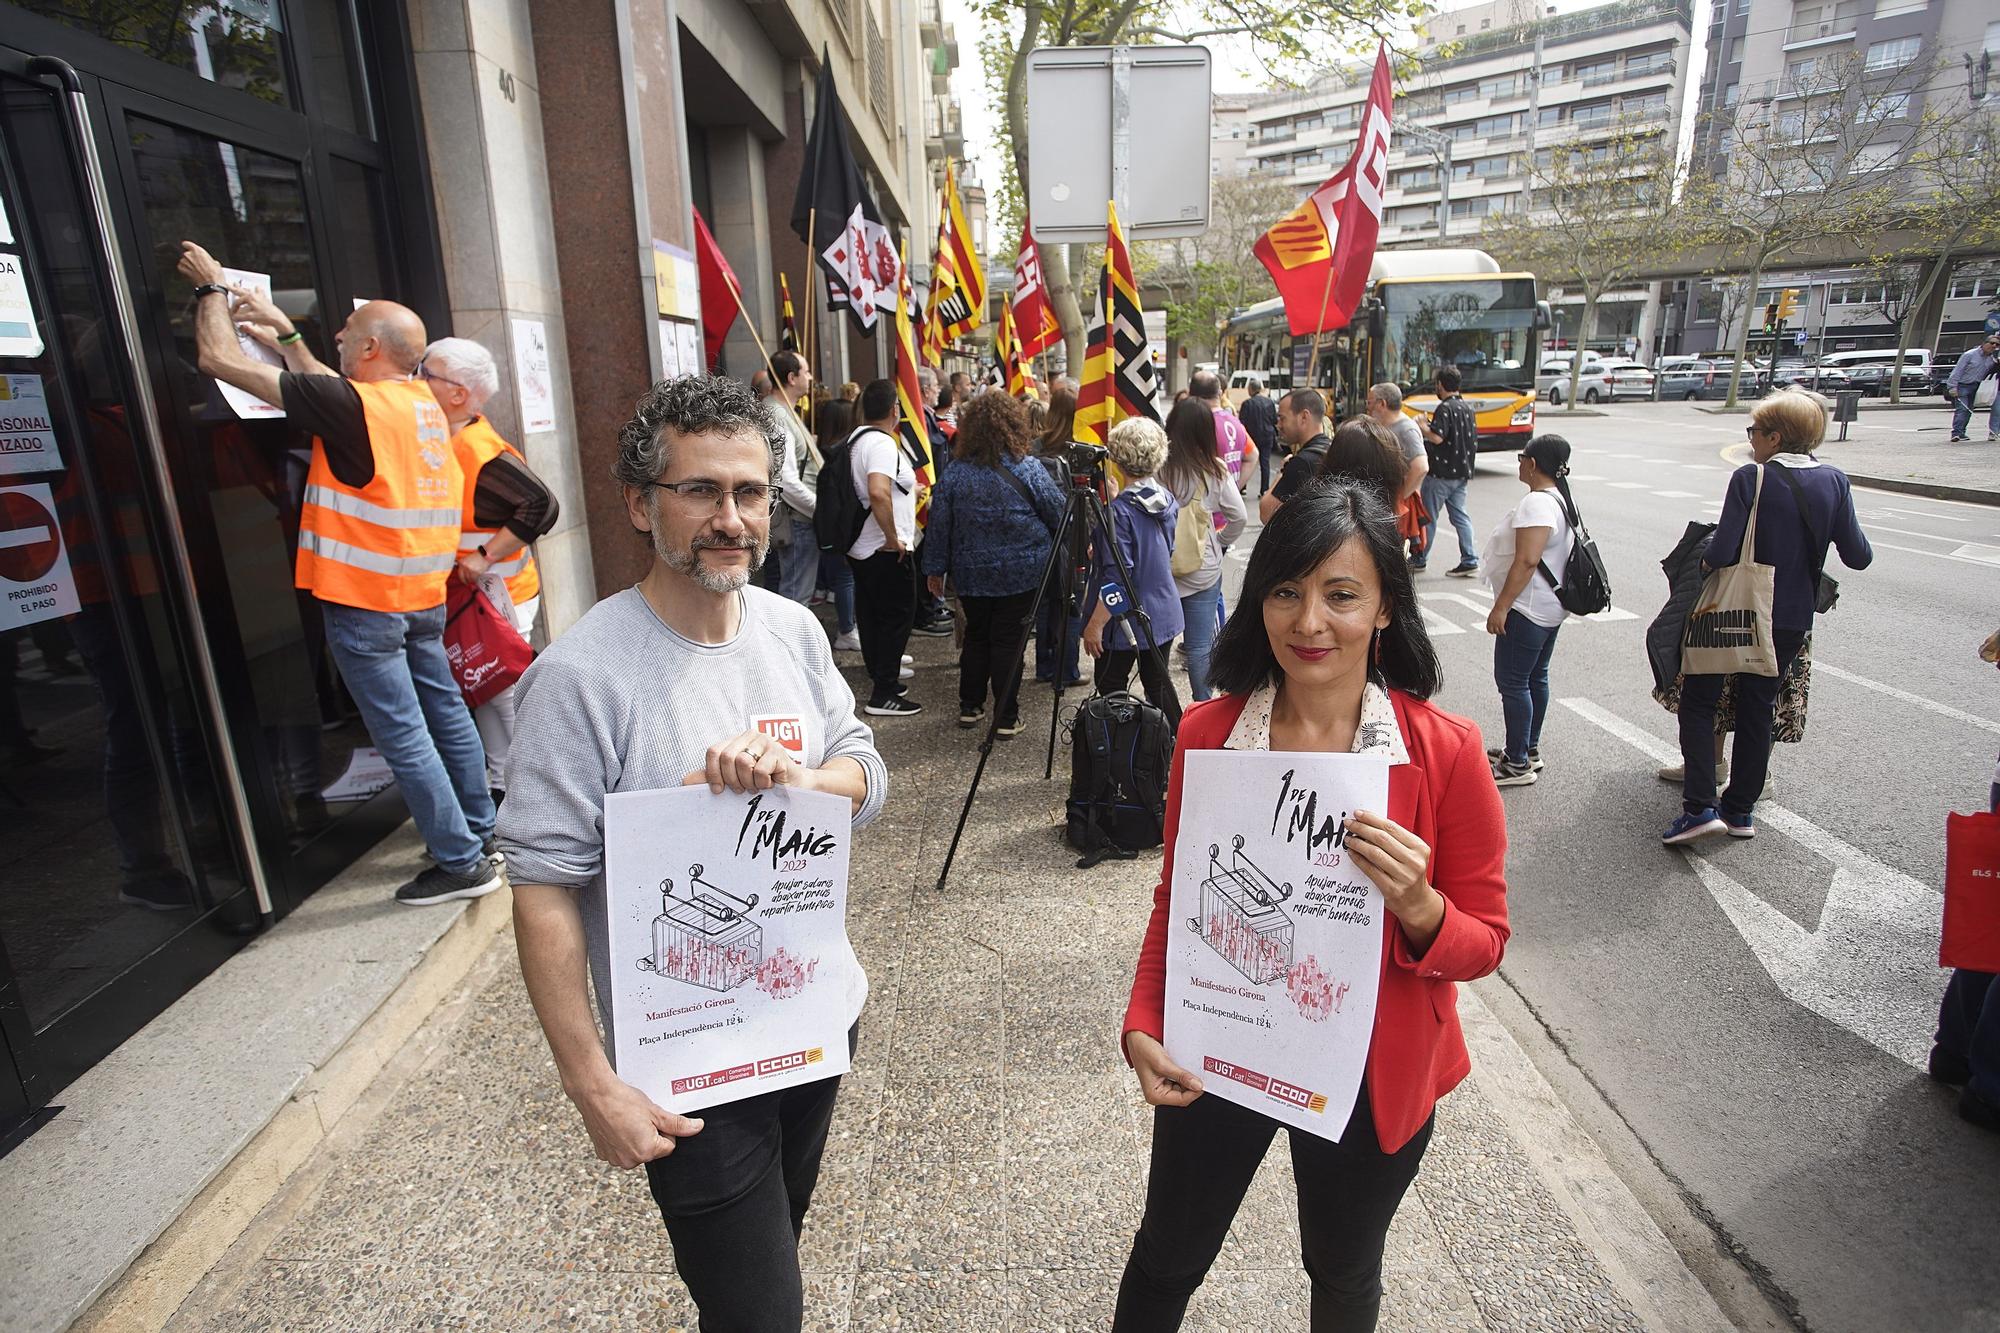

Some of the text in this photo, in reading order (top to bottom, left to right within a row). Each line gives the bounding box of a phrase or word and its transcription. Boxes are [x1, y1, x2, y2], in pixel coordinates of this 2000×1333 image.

[499, 67, 515, 104] 40
[8, 583, 58, 601] PROHIBIDO
[1105, 591, 1123, 606] Gi
[21, 598, 57, 613] EL PASO
[765, 720, 801, 742] UGT
[1271, 769, 1307, 836] 1 DE
[735, 794, 776, 857] 1 DE
[1287, 790, 1354, 861] MAi
[780, 860, 807, 873] 2023
[1313, 852, 1341, 869] 2023
[1972, 869, 1992, 878] ELS
[771, 877, 834, 893] Apujar salaris
[771, 888, 831, 903] abaixar preus
[1304, 873, 1369, 897] Apujar salaris
[1304, 887, 1366, 909] abaixar preus
[759, 900, 798, 919] repartir
[1292, 903, 1371, 926] repartir beneficis
[1190, 976, 1266, 1001] Manifestació Girona
[645, 997, 735, 1021] Manifestació Girona
[1182, 999, 1201, 1011] Plaça
[1202, 1003, 1254, 1024] Independència
[1256, 1017, 1265, 1026] 12
[639, 1036, 661, 1046] Plaça
[663, 1020, 724, 1040] Independència
[726, 1016, 736, 1026] 12
[760, 1054, 803, 1072] CCOO
[1214, 1061, 1245, 1082] UGT.cat
[685, 1074, 726, 1090] UGT.cat
[1270, 1082, 1309, 1104] CCOO
